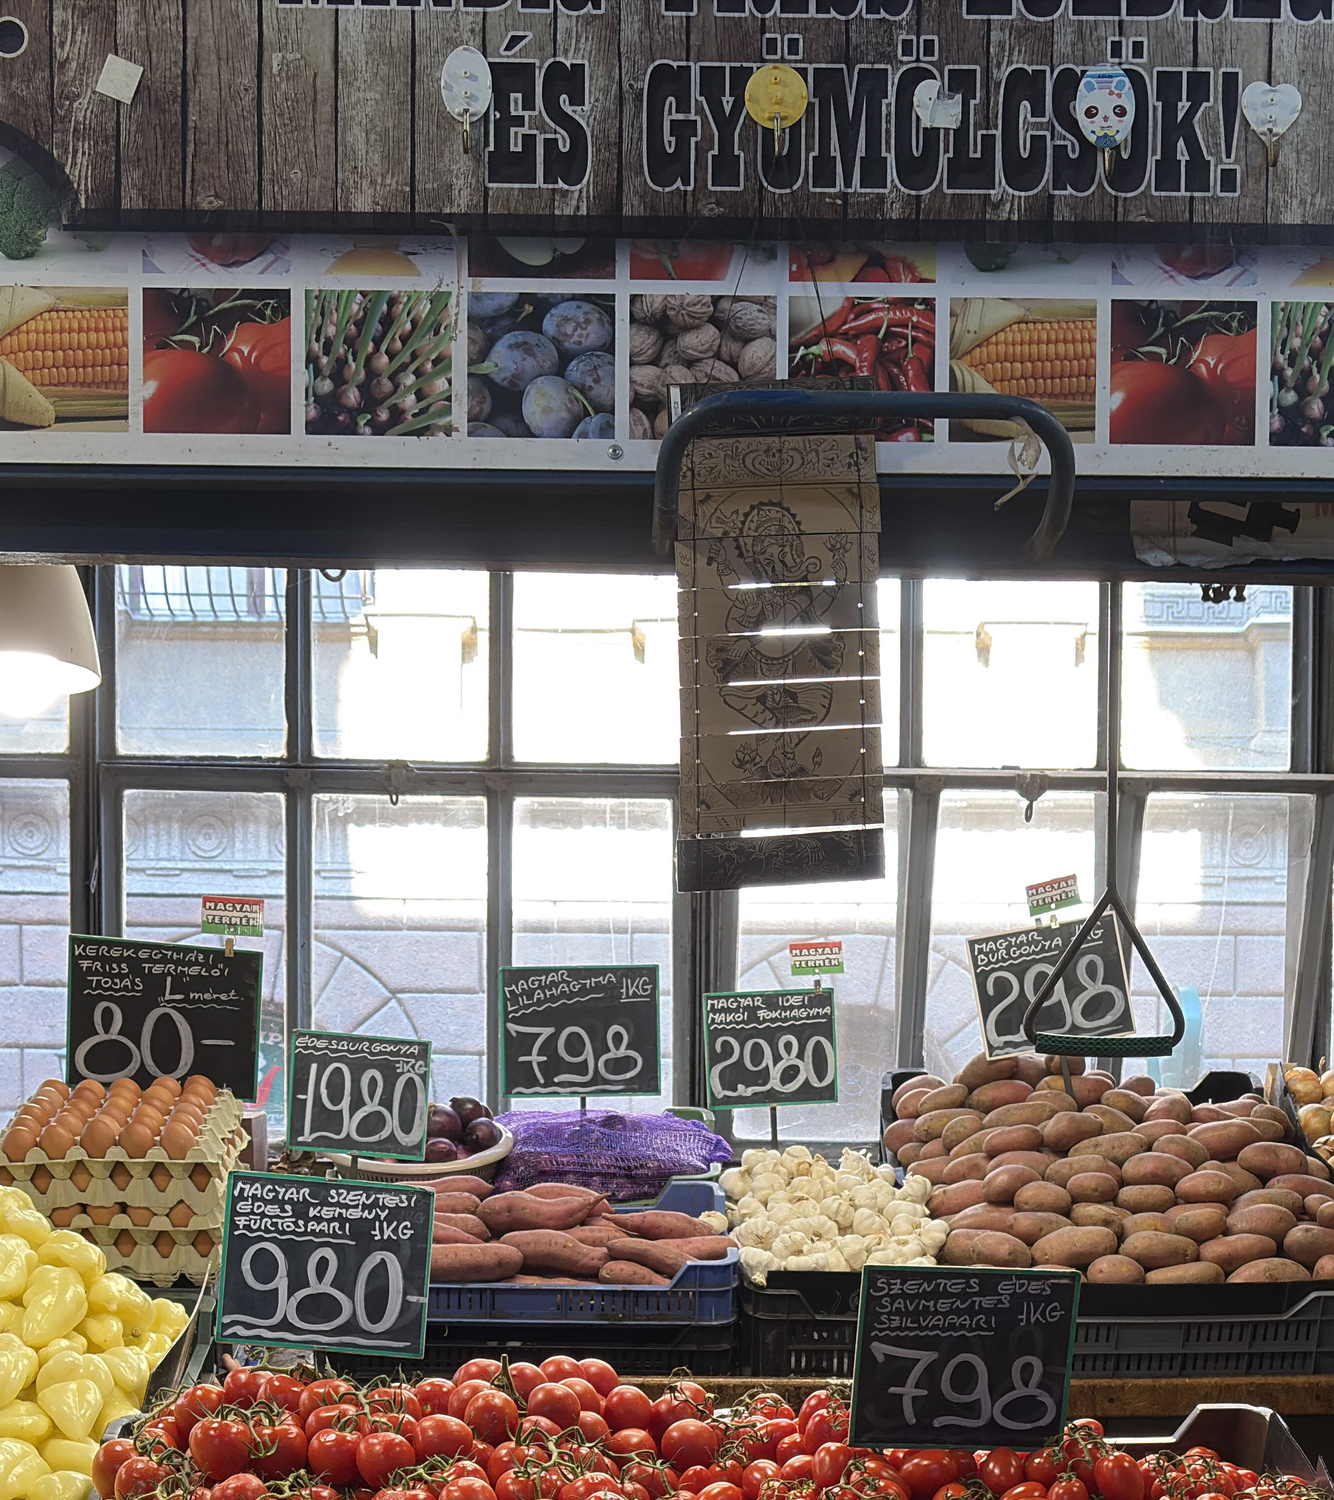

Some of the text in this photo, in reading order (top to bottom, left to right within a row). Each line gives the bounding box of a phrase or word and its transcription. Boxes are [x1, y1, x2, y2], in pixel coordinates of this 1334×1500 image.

[485, 31, 591, 190] ÉS
[1027, 878, 1076, 897] MAGYAR
[206, 901, 261, 912] MAGYAR
[1031, 890, 1076, 908] TERMÉK
[206, 914, 260, 926] TERMÉK
[791, 946, 840, 957] MAGYAR
[974, 932, 1043, 955] MAGYAR
[977, 937, 1062, 965] BURGONYA
[78, 960, 129, 974] FRISS
[793, 958, 840, 969] TERMÉK
[504, 970, 572, 998] MAGYAR
[507, 973, 617, 1011] LILAHAGYMA
[707, 995, 808, 1011] MAGYAR IDEI
[986, 954, 1126, 1048] 298
[757, 1006, 832, 1020] FOKHAGYMA
[295, 1035, 419, 1056] ÉDESBURGONYA
[505, 1022, 643, 1084] 798
[395, 1060, 428, 1074] 1KG
[709, 1035, 834, 1098] 2980
[296, 1062, 426, 1146] 1980
[234, 1181, 417, 1207] MAGYAR SZENTESI
[237, 1198, 389, 1220] ÉDES KEMÉNY
[371, 1221, 414, 1240] 1KG
[998, 1276, 1052, 1295] ÉDES
[876, 1295, 1010, 1313] SAVMENTES
[874, 1302, 1065, 1328] SZILVAPARI 1KG
[870, 1341, 1056, 1430] 798
